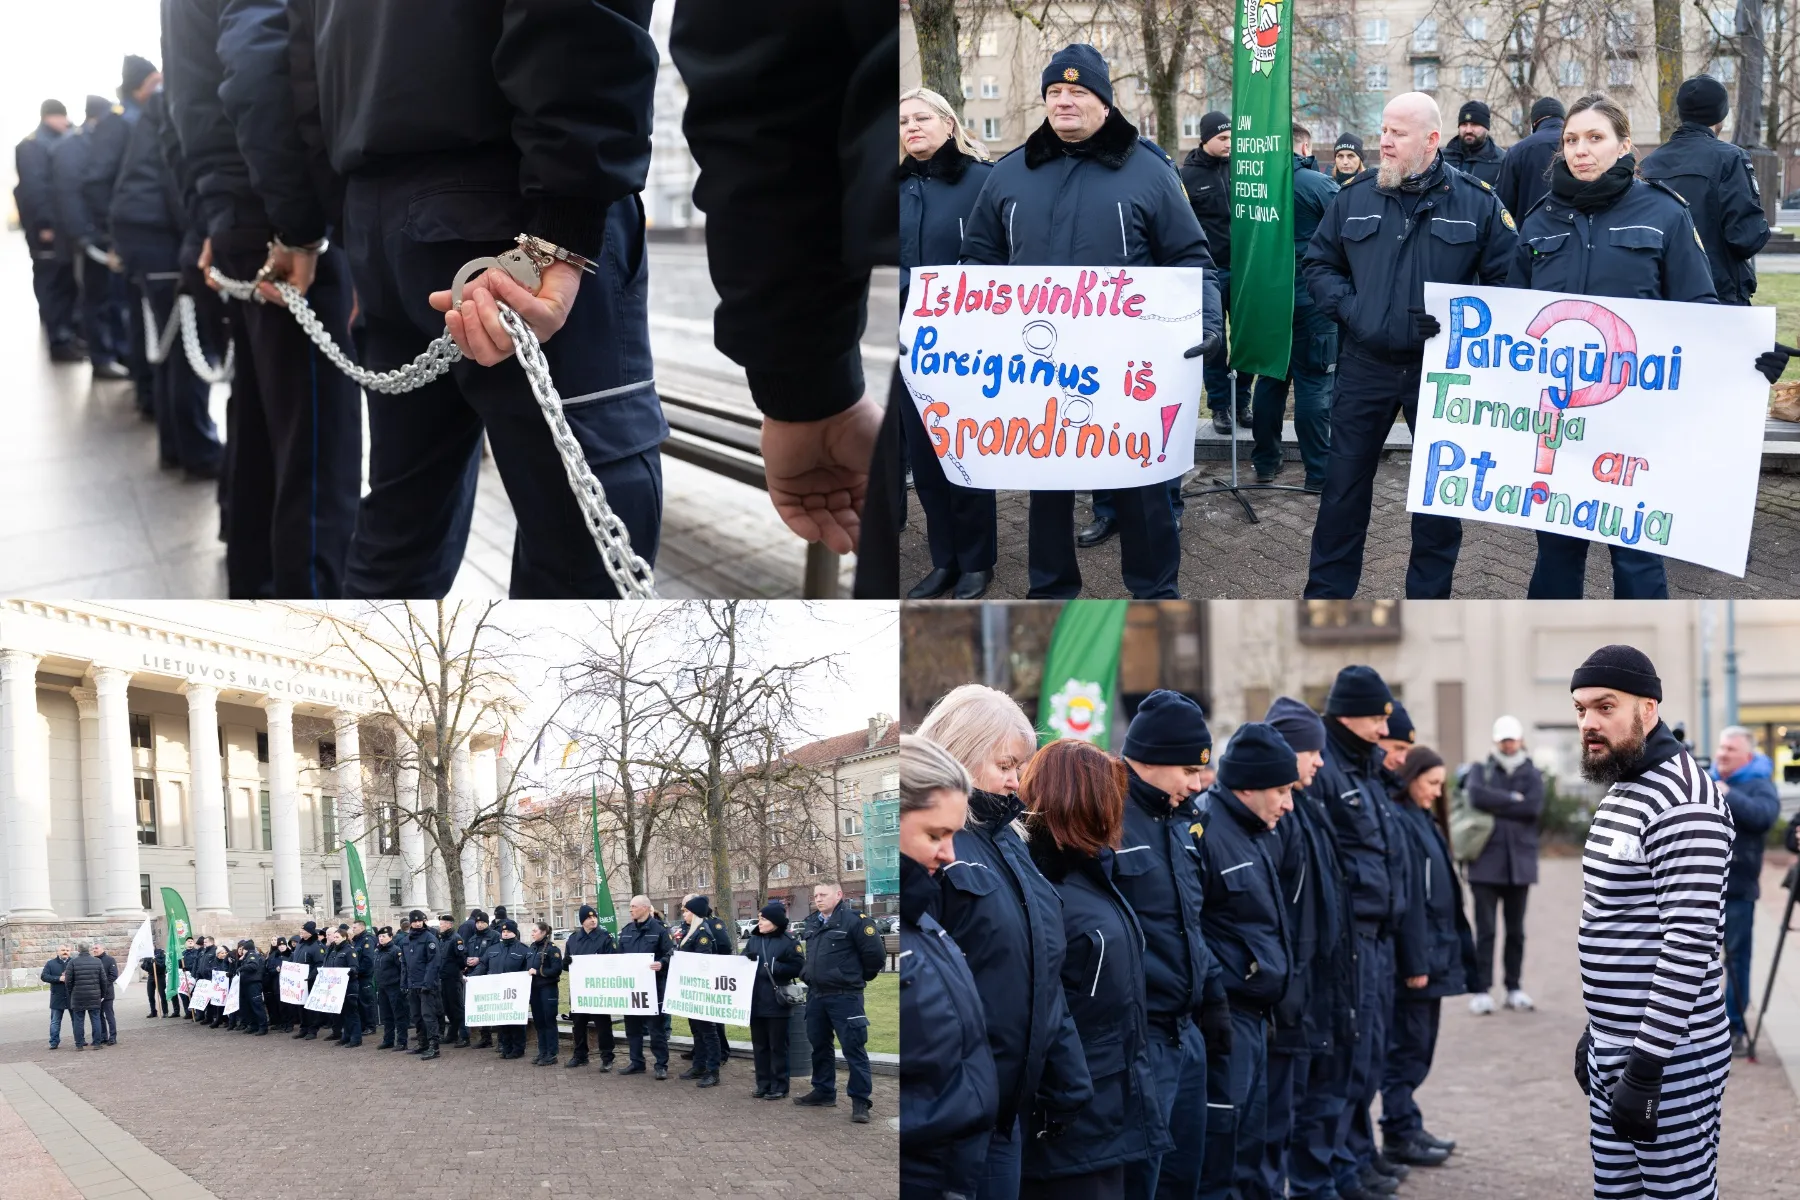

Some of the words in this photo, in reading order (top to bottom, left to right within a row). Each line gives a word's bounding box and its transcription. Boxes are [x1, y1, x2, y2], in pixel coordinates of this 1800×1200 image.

[1237, 115, 1251, 131] LAW
[1235, 203, 1246, 219] OF
[911, 325, 1100, 398] Pareigūnus
[1124, 361, 1156, 401] iš
[1446, 296, 1682, 408] Pareigūnai
[1427, 372, 1586, 450] Tarnauja
[1592, 452, 1649, 486] ar
[1422, 440, 1673, 545] Patarnauja
[143, 654, 236, 682] LIETUVOS
[503, 988, 517, 1000] JŪS
[714, 975, 737, 991] JŪS
[577, 994, 629, 1008] BAUDŽIAVAI
[631, 992, 650, 1008] NE
